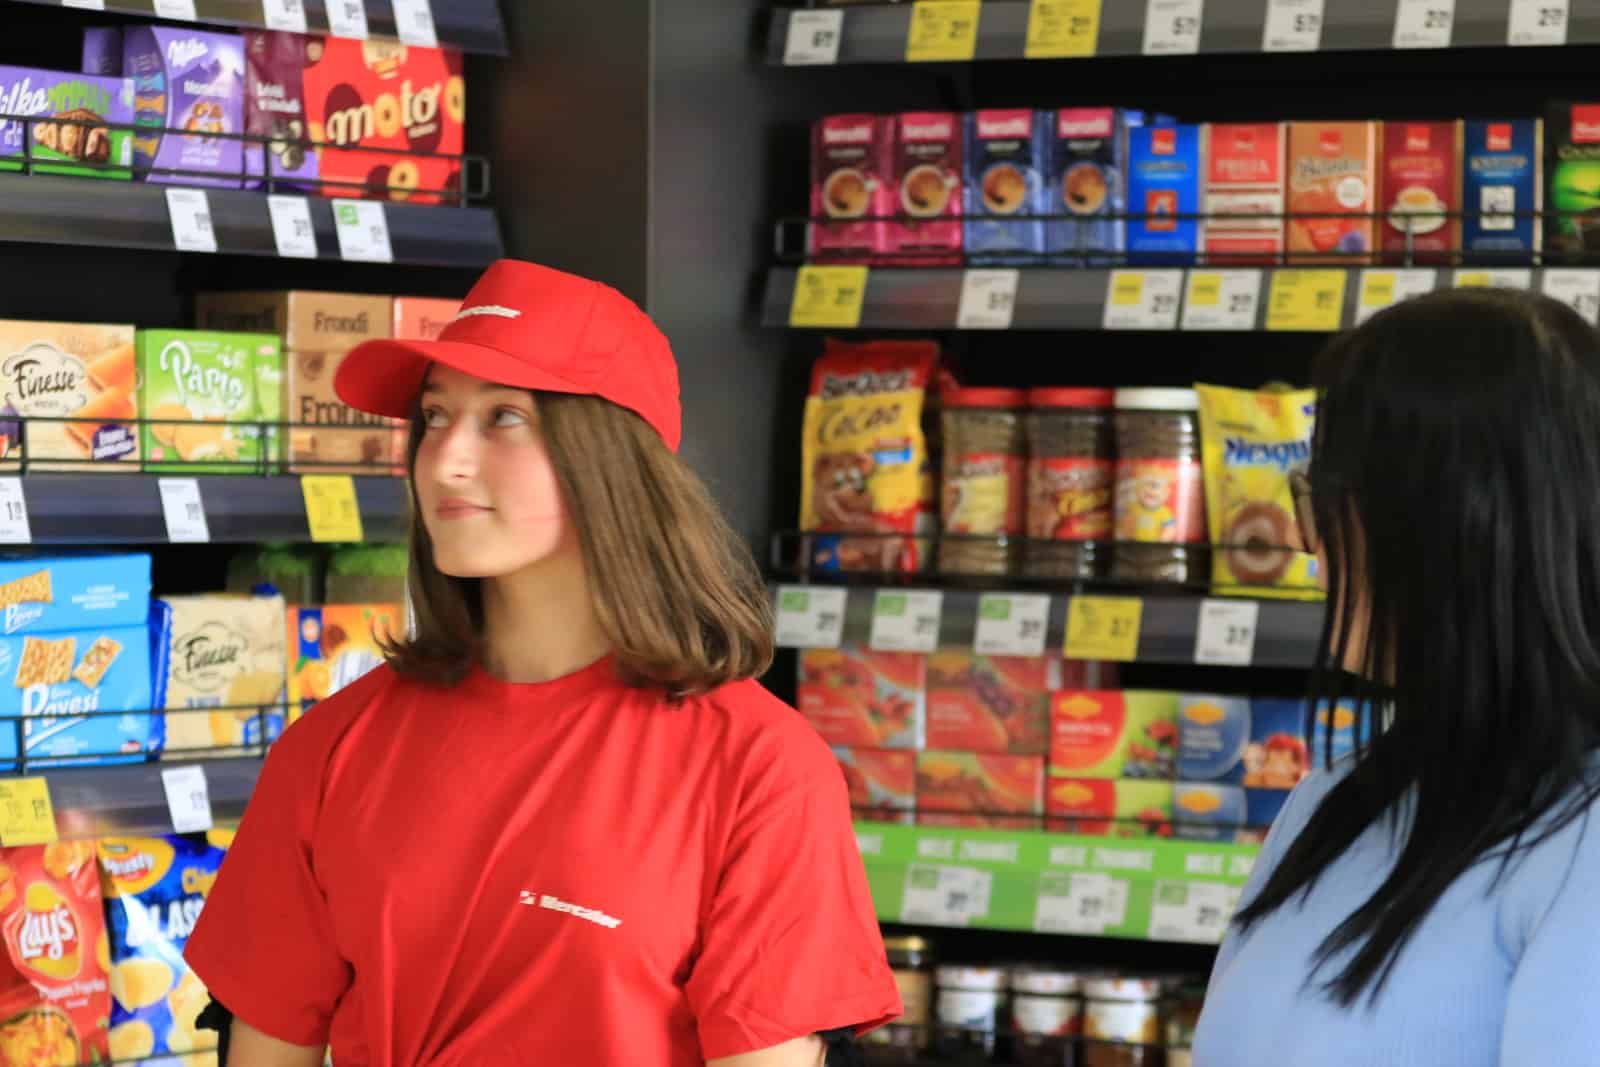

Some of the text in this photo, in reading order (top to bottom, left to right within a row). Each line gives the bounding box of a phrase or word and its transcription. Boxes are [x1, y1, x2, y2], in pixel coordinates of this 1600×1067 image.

[313, 310, 369, 333] Frondi
[13, 359, 76, 400] Finesse
[23, 683, 100, 736] Pavesi
[21, 903, 76, 960] Lay's
